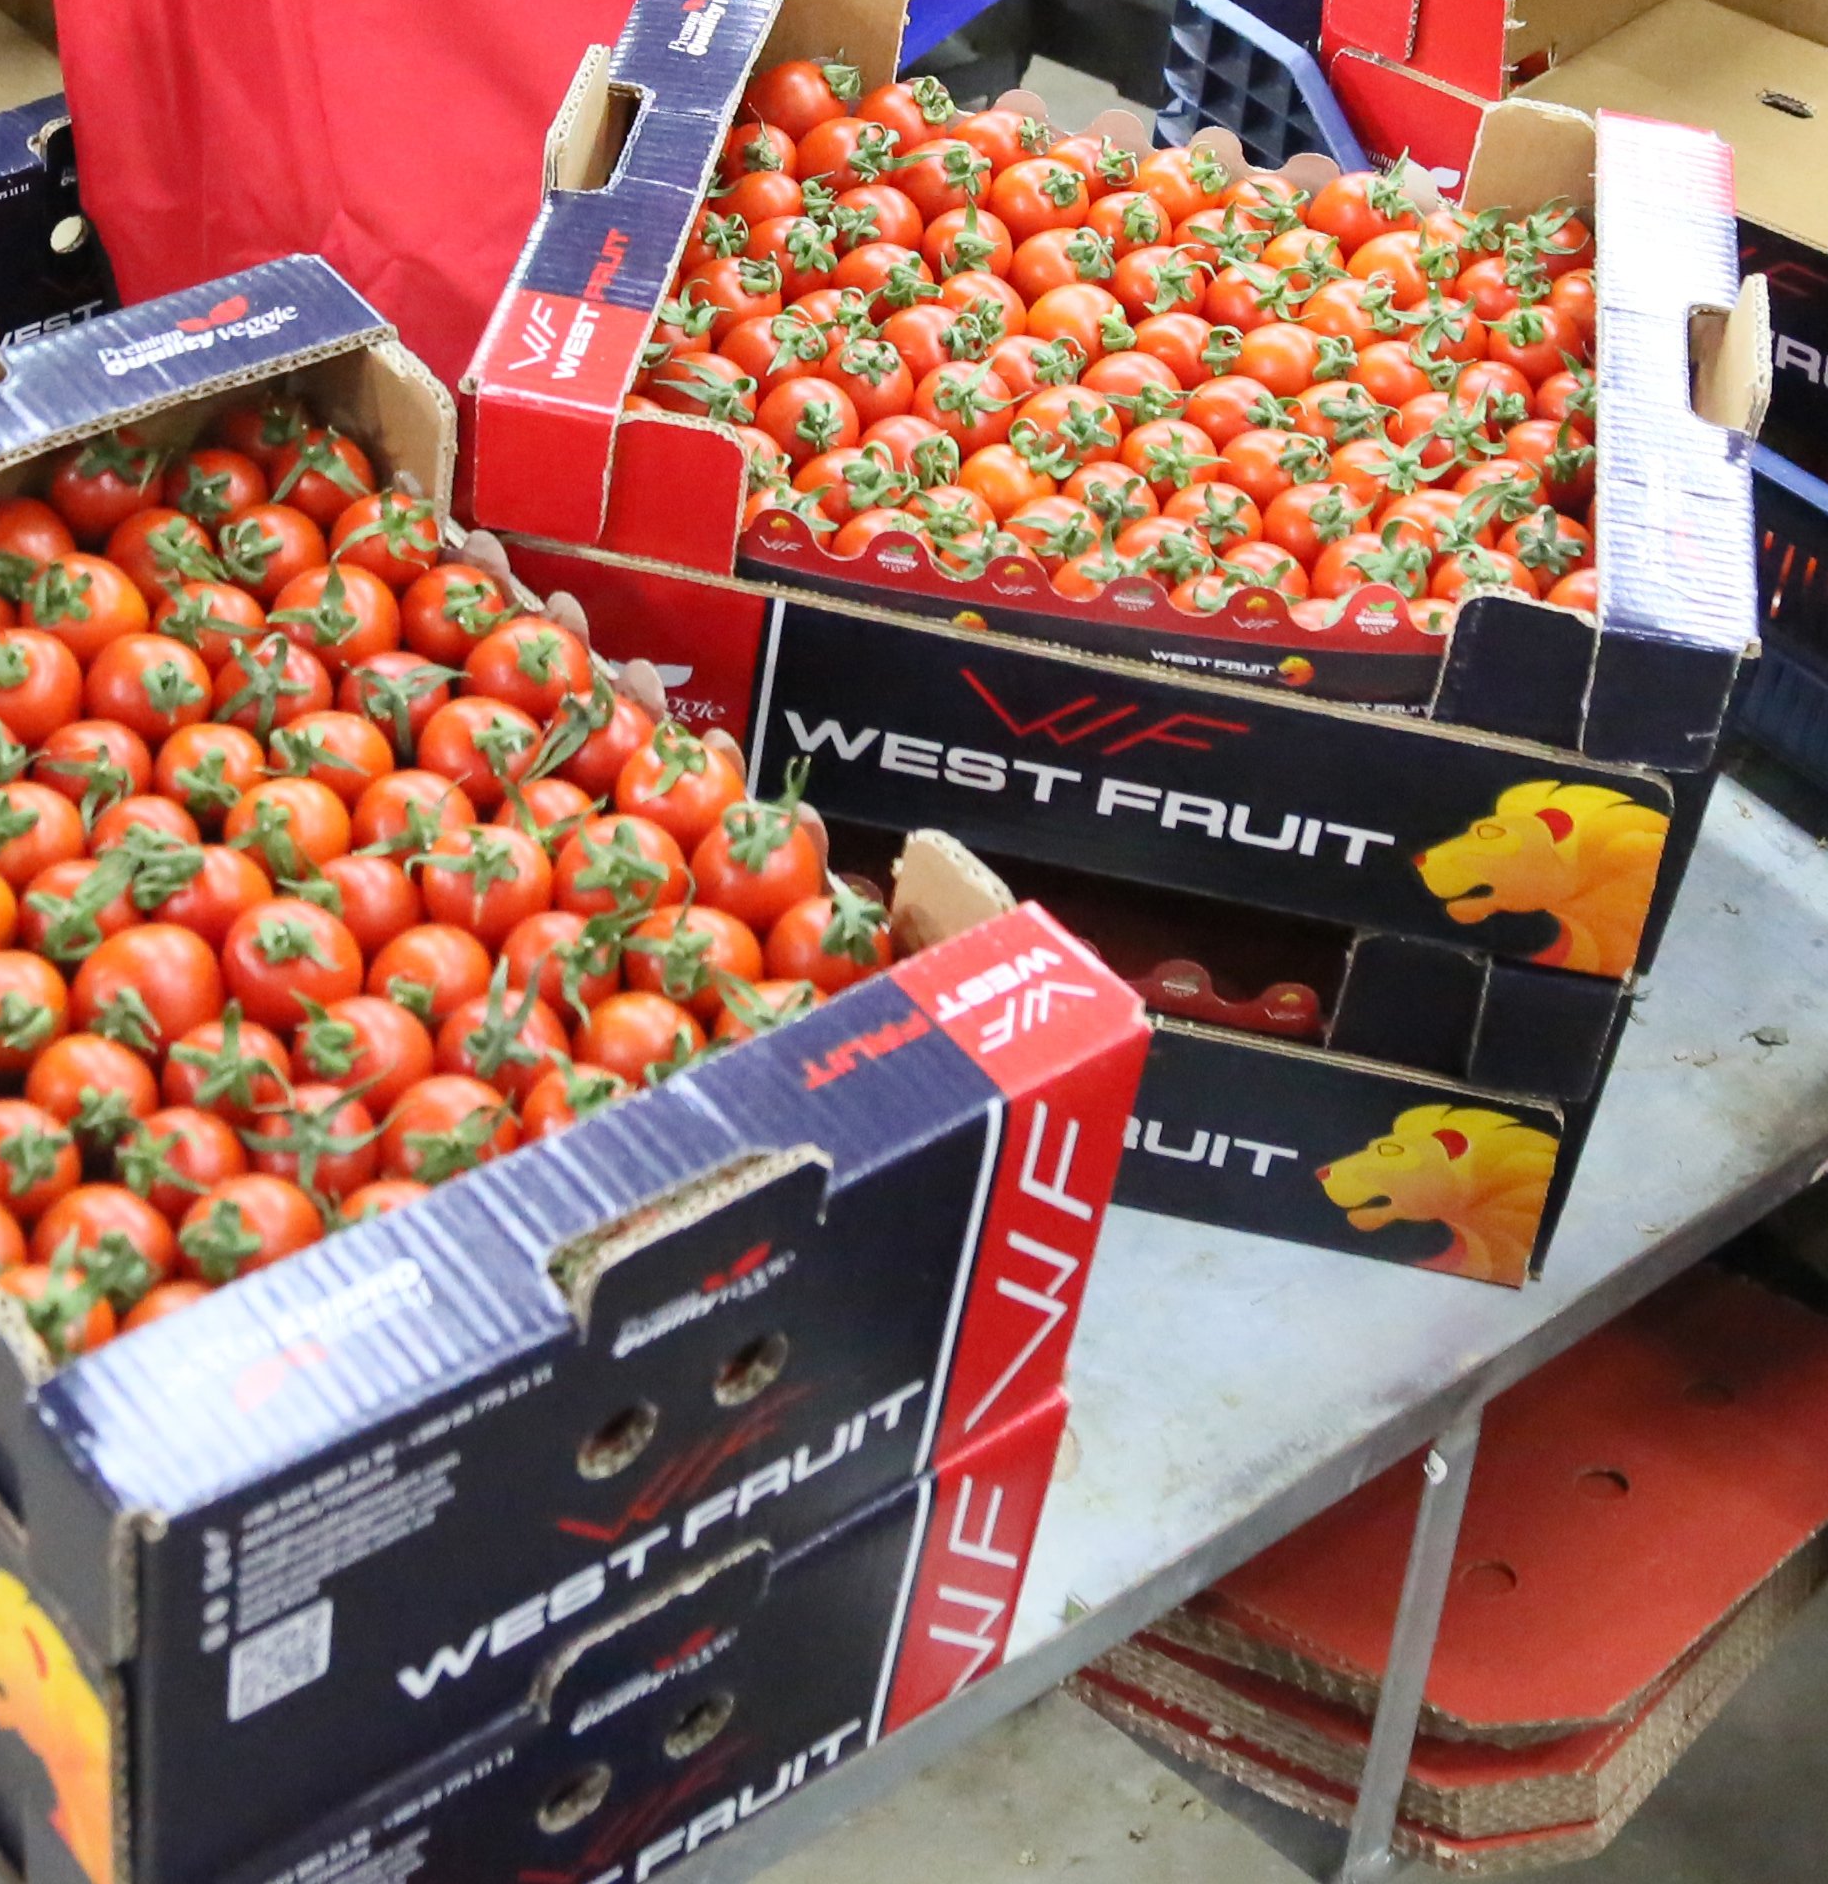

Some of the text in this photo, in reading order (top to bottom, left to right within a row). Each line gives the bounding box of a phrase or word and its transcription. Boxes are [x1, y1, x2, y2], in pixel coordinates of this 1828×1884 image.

[97, 329, 185, 364] Premium
[104, 305, 299, 377] Quality veggie
[551, 228, 631, 380] WEST FRUIT
[1150, 648, 1277, 676] WEST FRUIT
[784, 709, 1395, 867] WEST FRUIT
[803, 945, 1062, 1092] WEST FRUIT
[1122, 1115, 1298, 1177] RUIT
[396, 1524, 671, 1700] WEST
[681, 1378, 926, 1550] FRUIT
[635, 1719, 864, 1884] FRUIT
